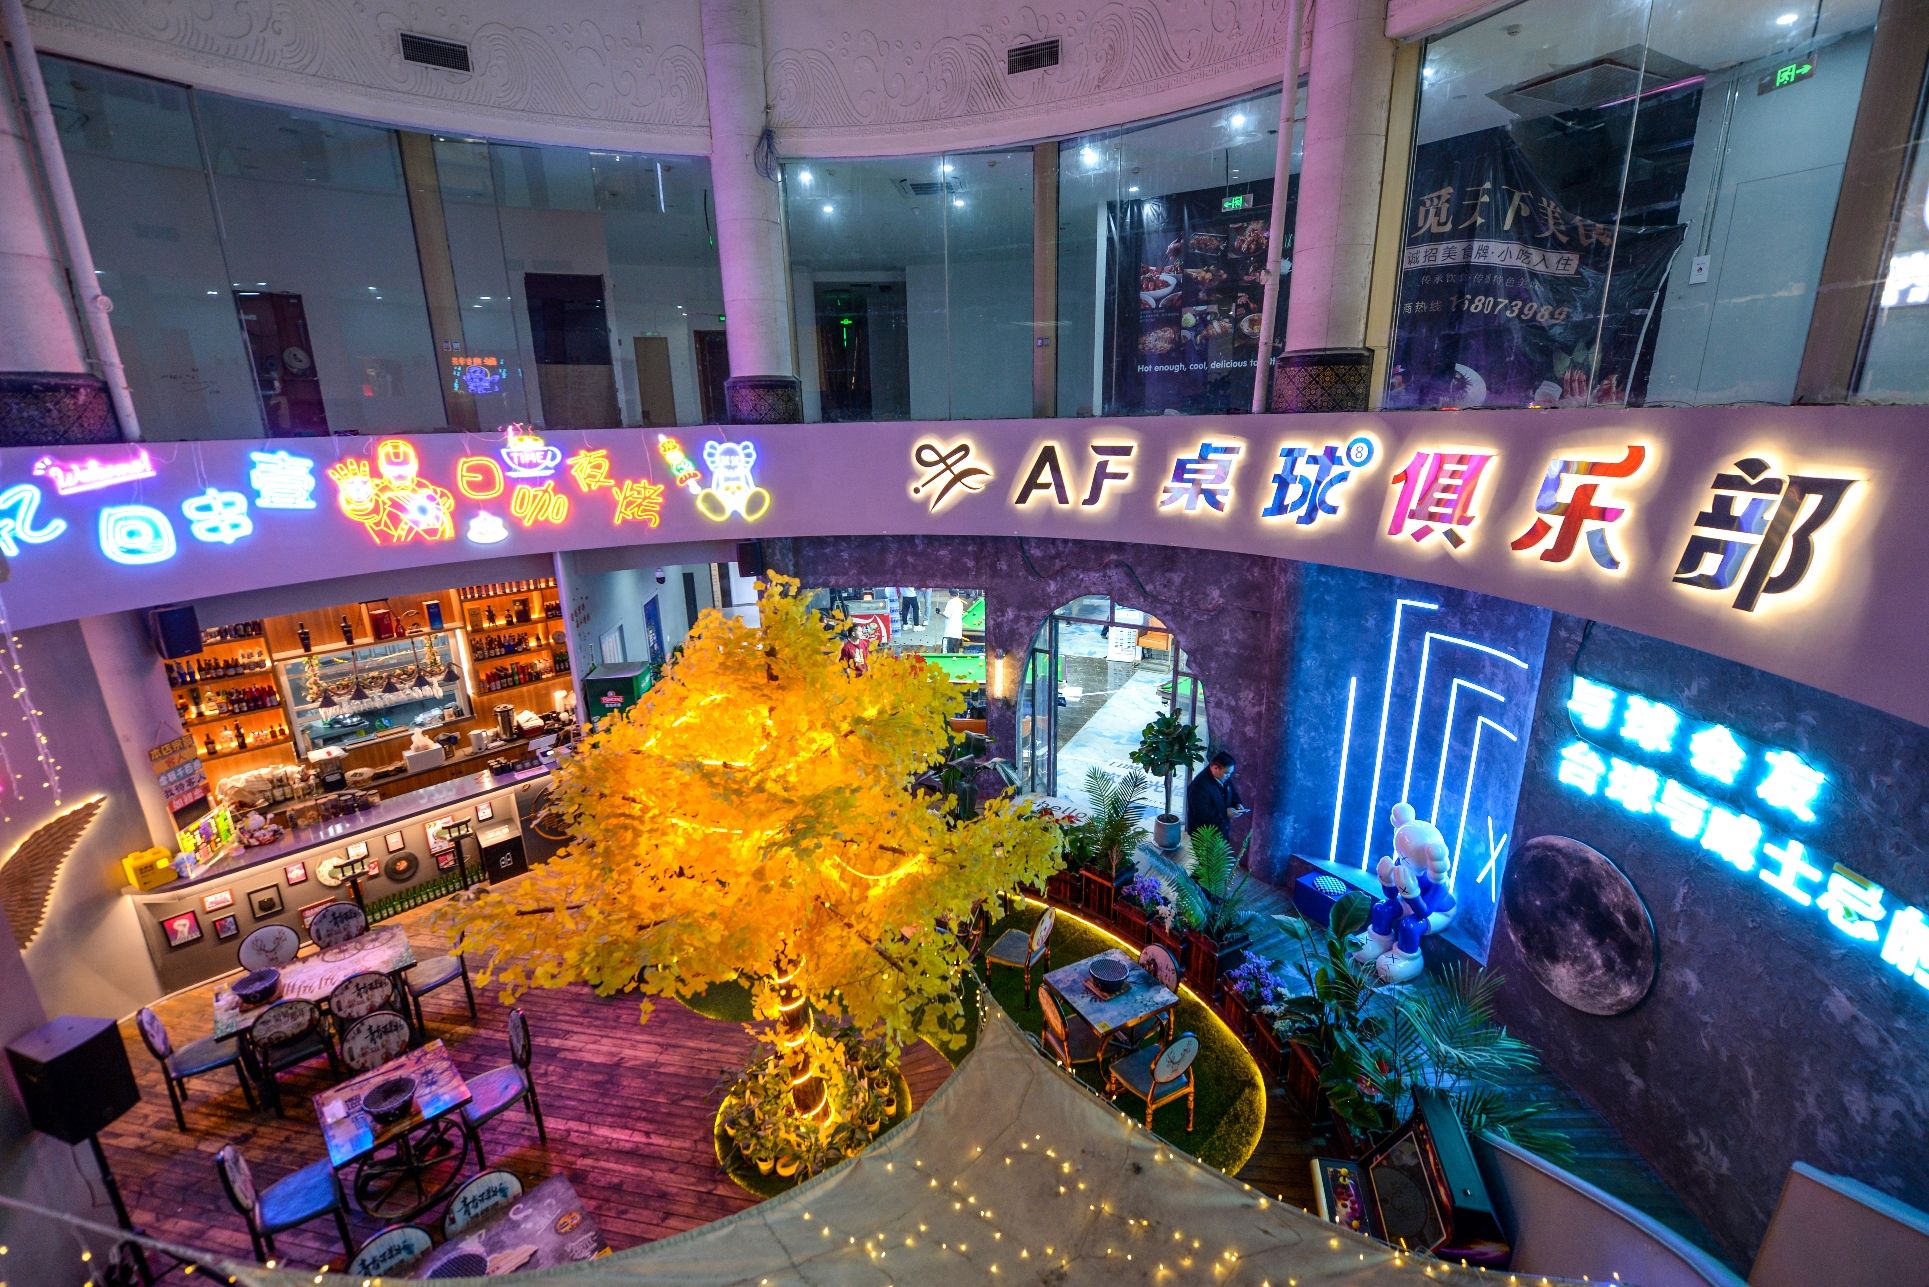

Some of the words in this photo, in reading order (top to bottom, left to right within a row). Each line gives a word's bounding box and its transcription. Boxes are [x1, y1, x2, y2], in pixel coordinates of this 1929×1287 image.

[1138, 364, 1152, 373] Hot
[1154, 362, 1187, 373] enough,
[1189, 362, 1208, 371] cool,
[1210, 359, 1247, 369] delicious
[510, 451, 546, 465] TIME
